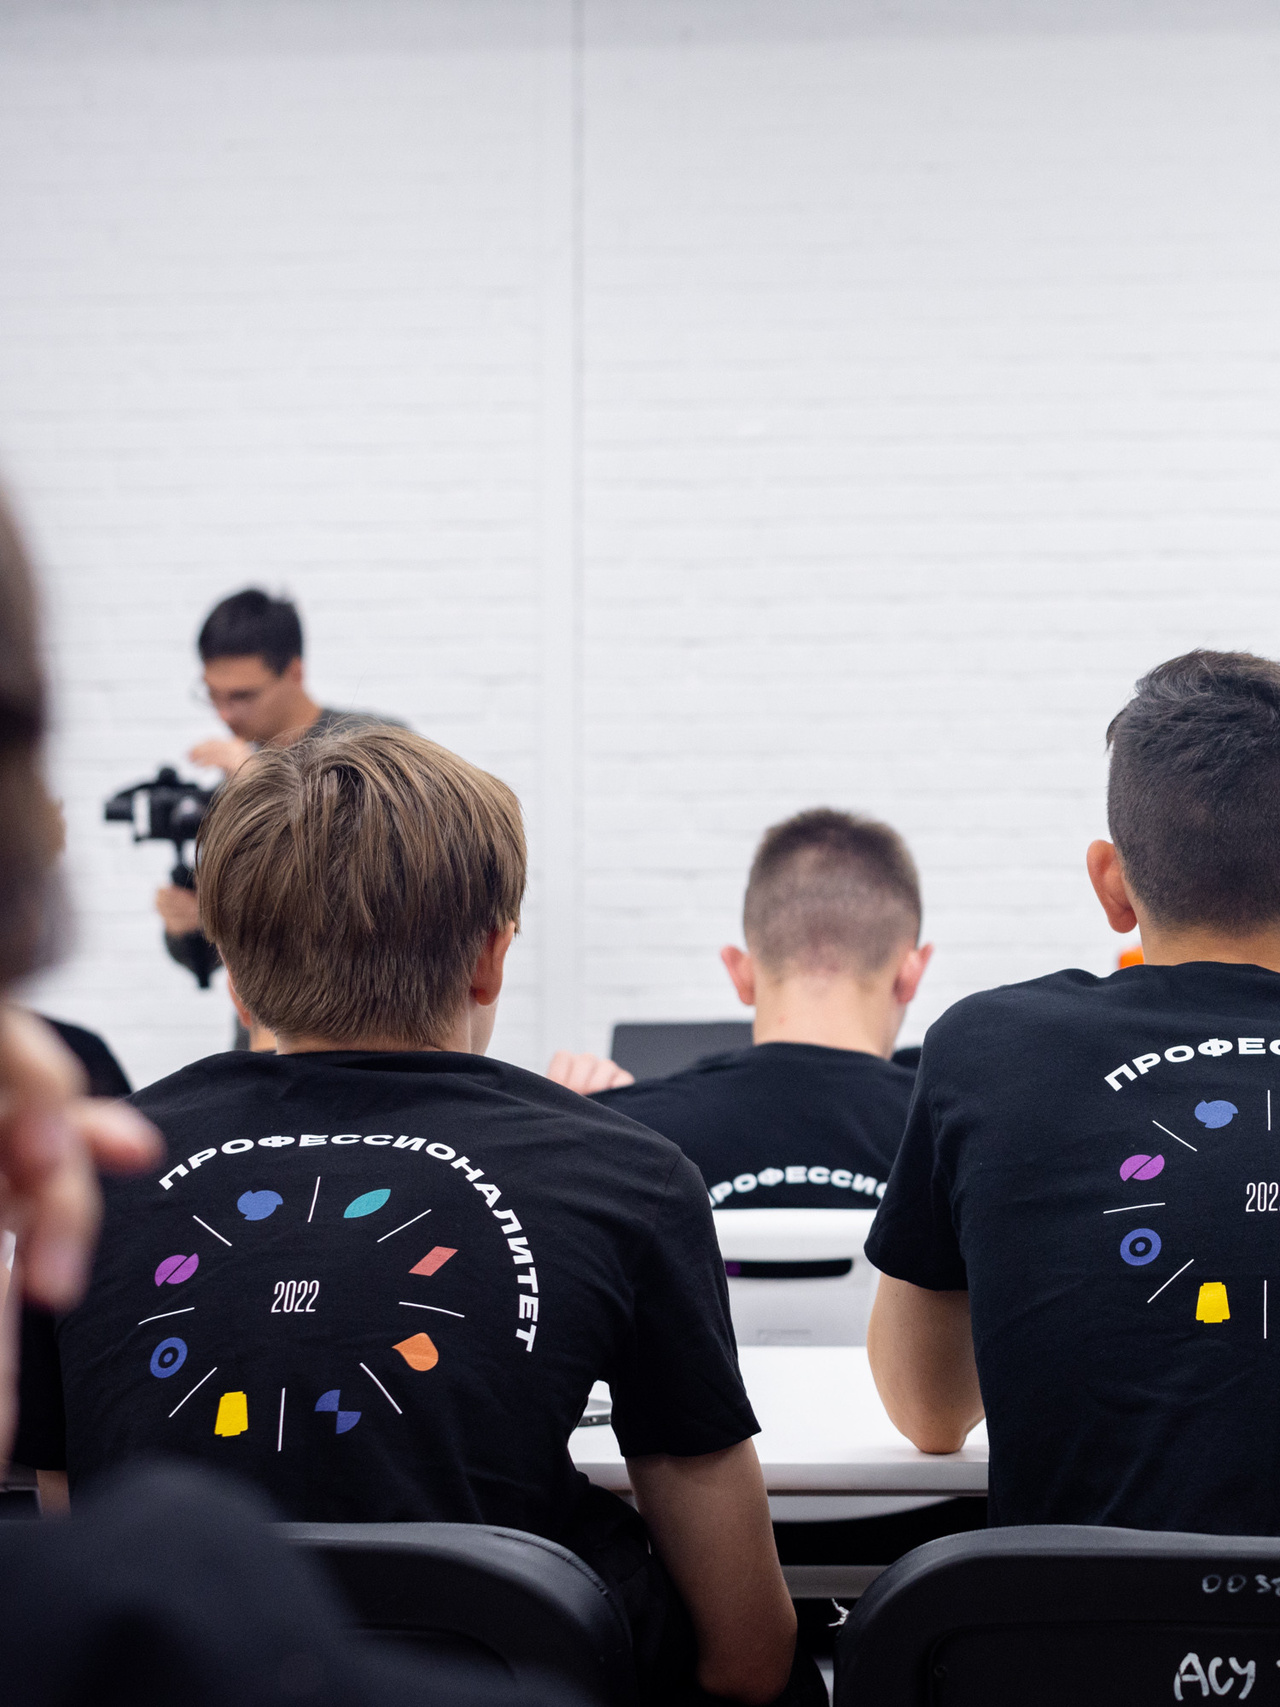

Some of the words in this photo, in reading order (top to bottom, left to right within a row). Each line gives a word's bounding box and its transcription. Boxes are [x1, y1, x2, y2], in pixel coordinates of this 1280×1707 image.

[159, 1134, 539, 1353] ПРОФЕССИОНАЛИТЕТ
[270, 1279, 320, 1314] 2022
[1174, 1652, 1256, 1701] АСУ
